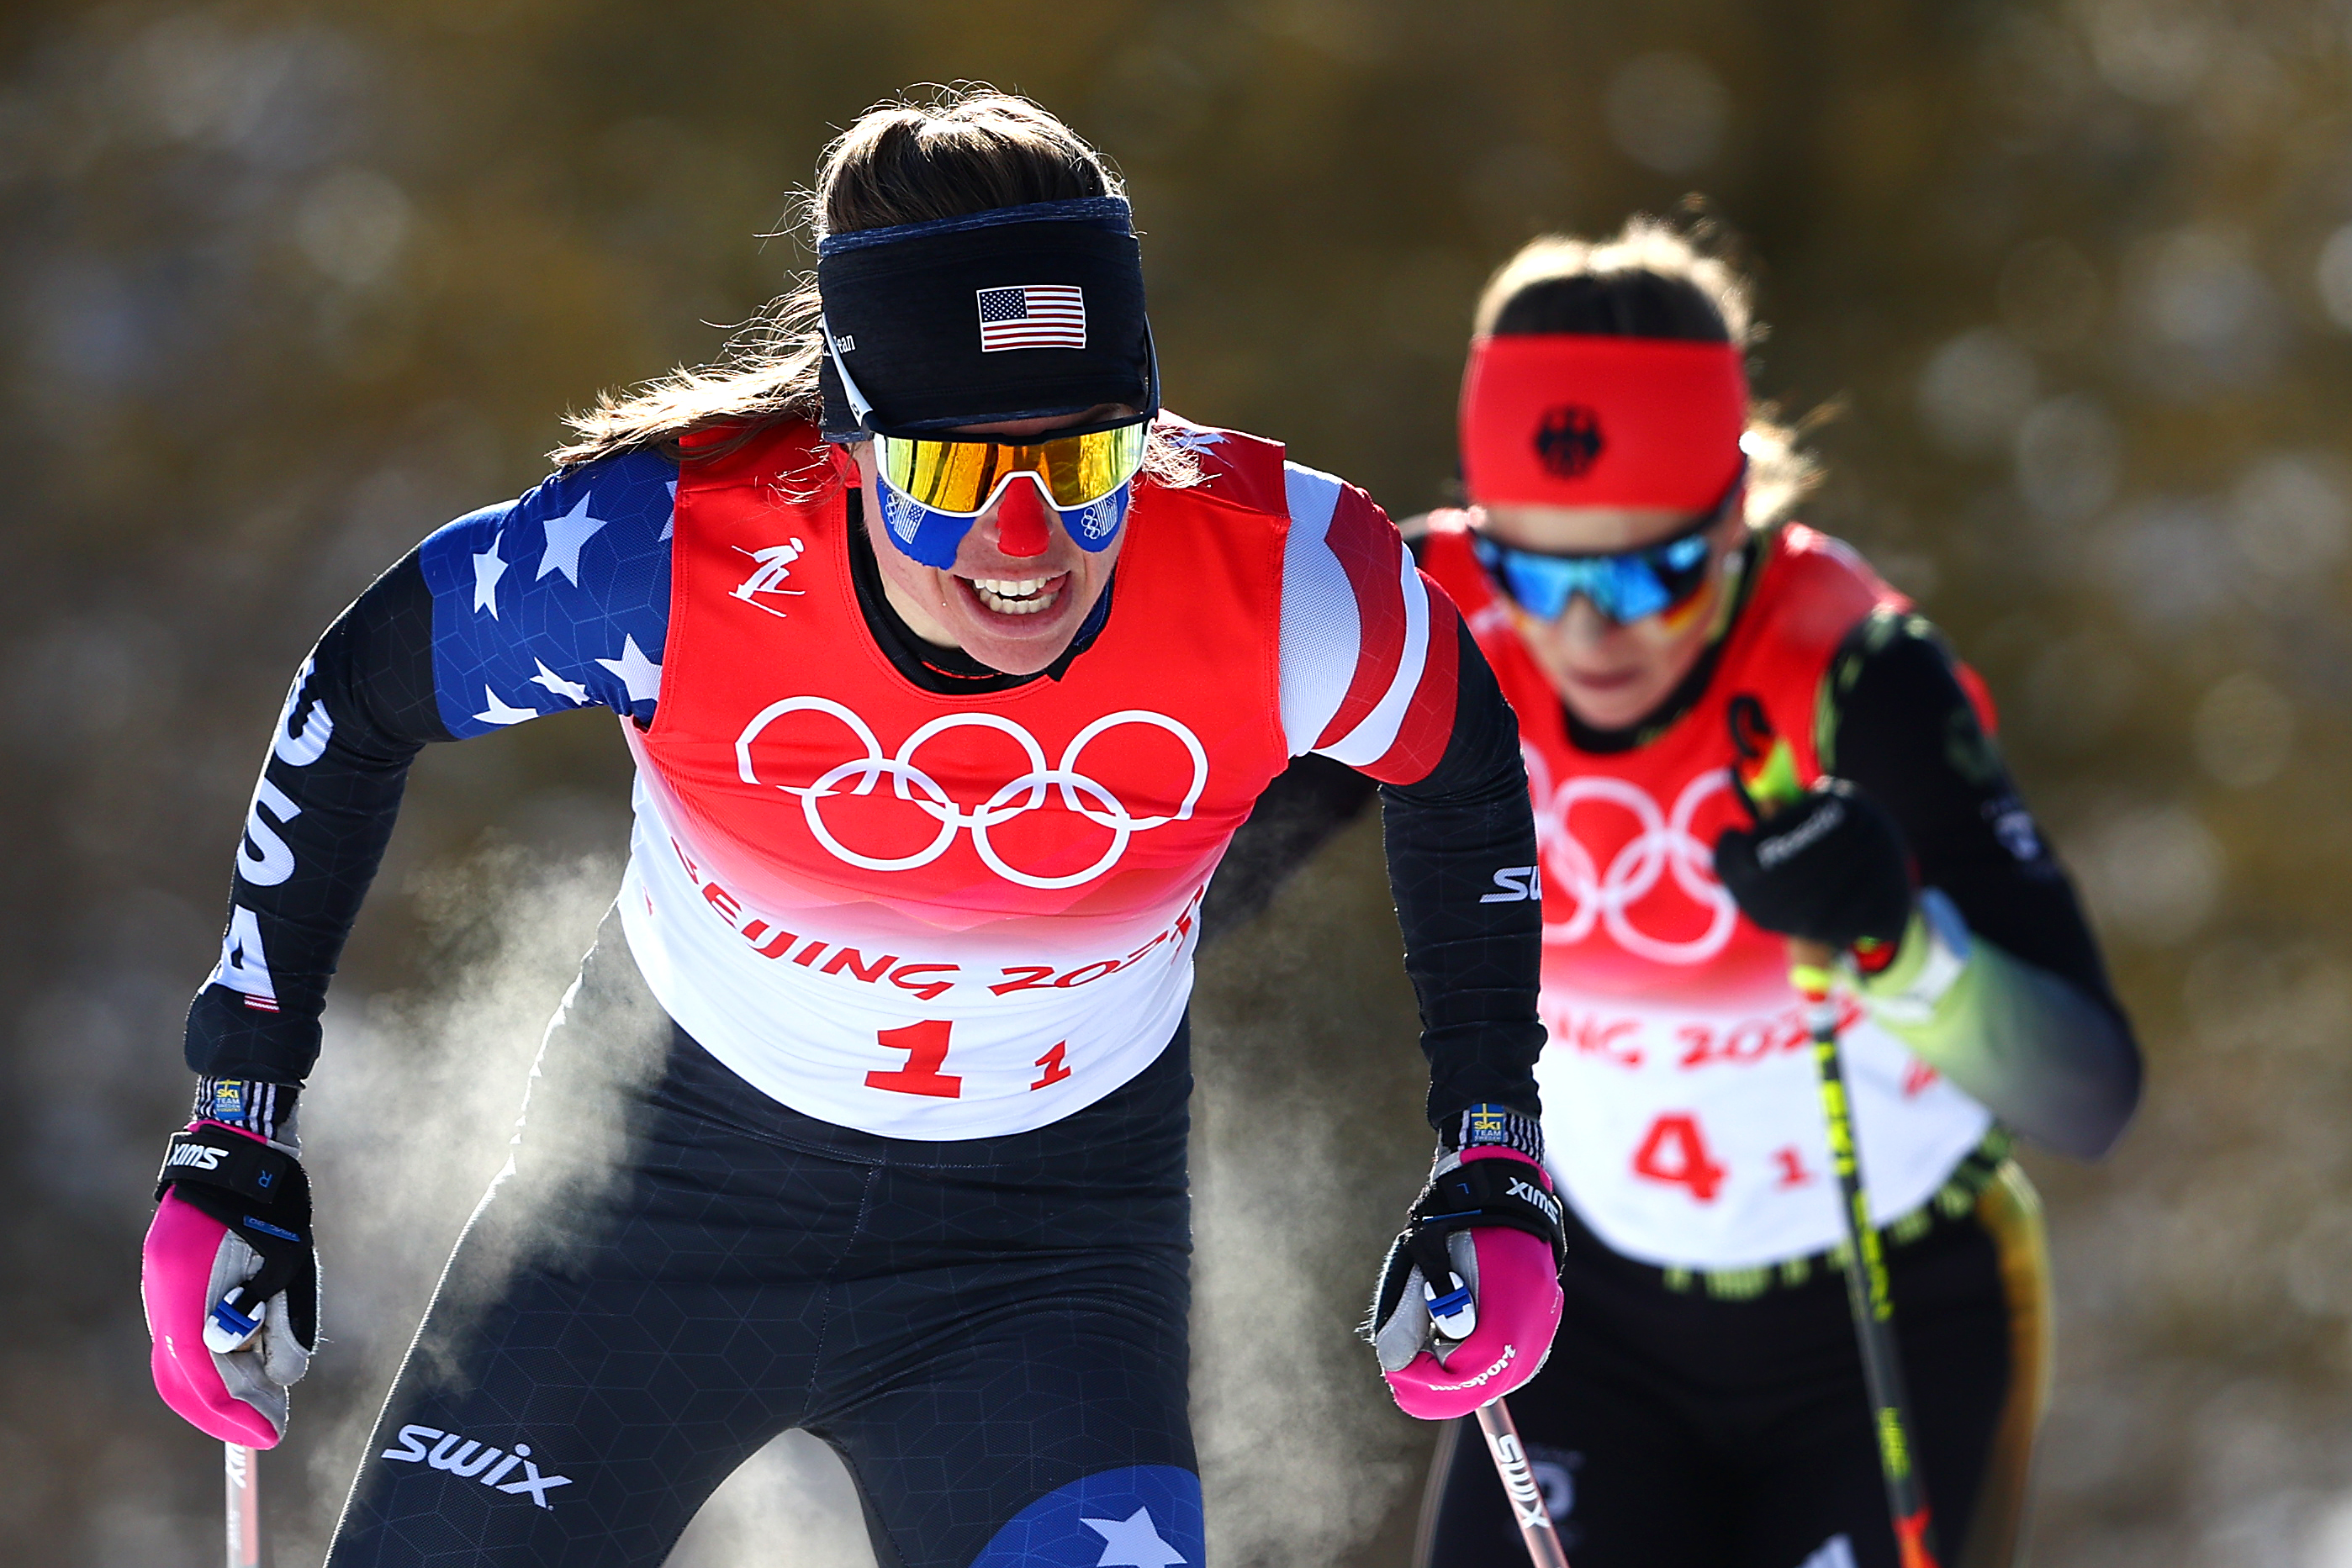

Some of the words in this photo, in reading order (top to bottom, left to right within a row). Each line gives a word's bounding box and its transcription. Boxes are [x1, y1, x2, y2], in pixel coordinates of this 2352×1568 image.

[198, 657, 334, 1012] USA
[864, 1019, 962, 1099] 1
[1030, 1039, 1072, 1092] 1
[1633, 1112, 1726, 1201] 4
[1773, 1147, 1811, 1188] 1
